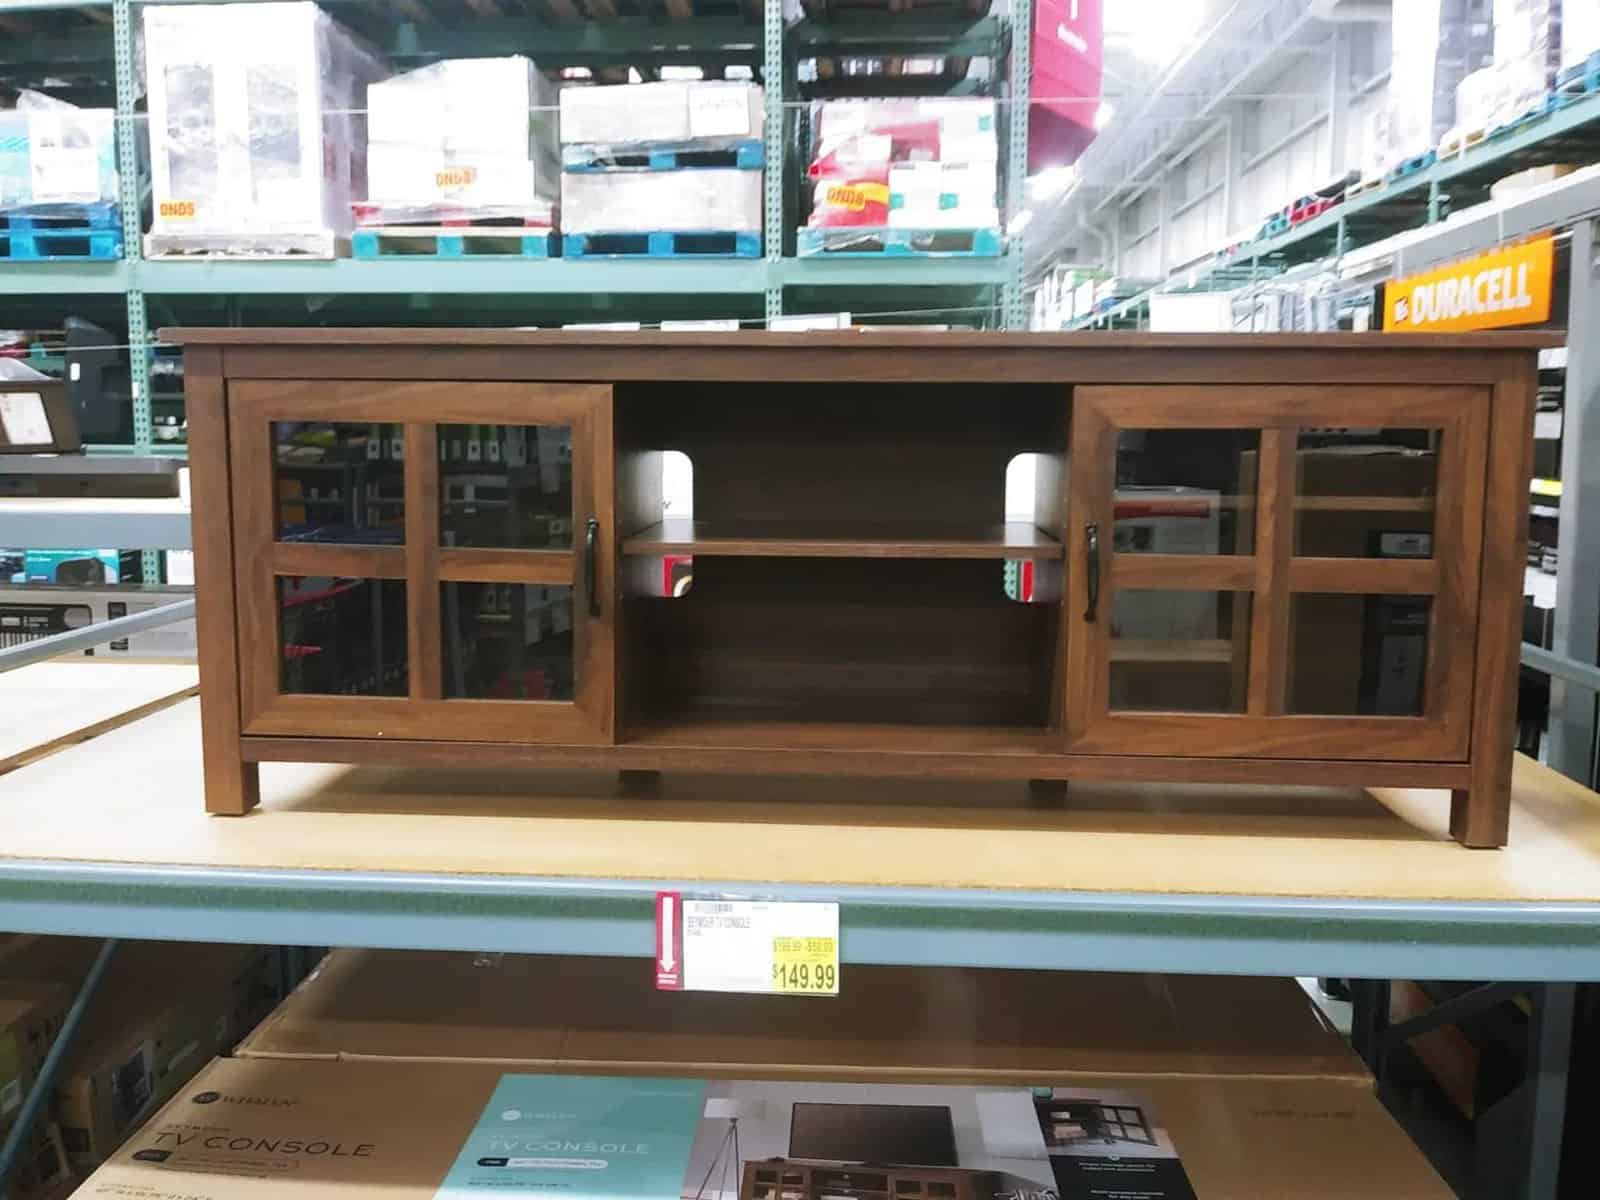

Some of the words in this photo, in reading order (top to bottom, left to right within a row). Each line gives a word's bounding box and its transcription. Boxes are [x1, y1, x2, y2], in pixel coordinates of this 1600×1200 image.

[1411, 263, 1531, 325] DURACELL
[772, 963, 835, 989] $149.99
[154, 1131, 197, 1146] TV
[203, 1136, 376, 1157] CONSOLE
[488, 1138, 520, 1151] TV
[525, 1141, 650, 1155] CONSOLE
